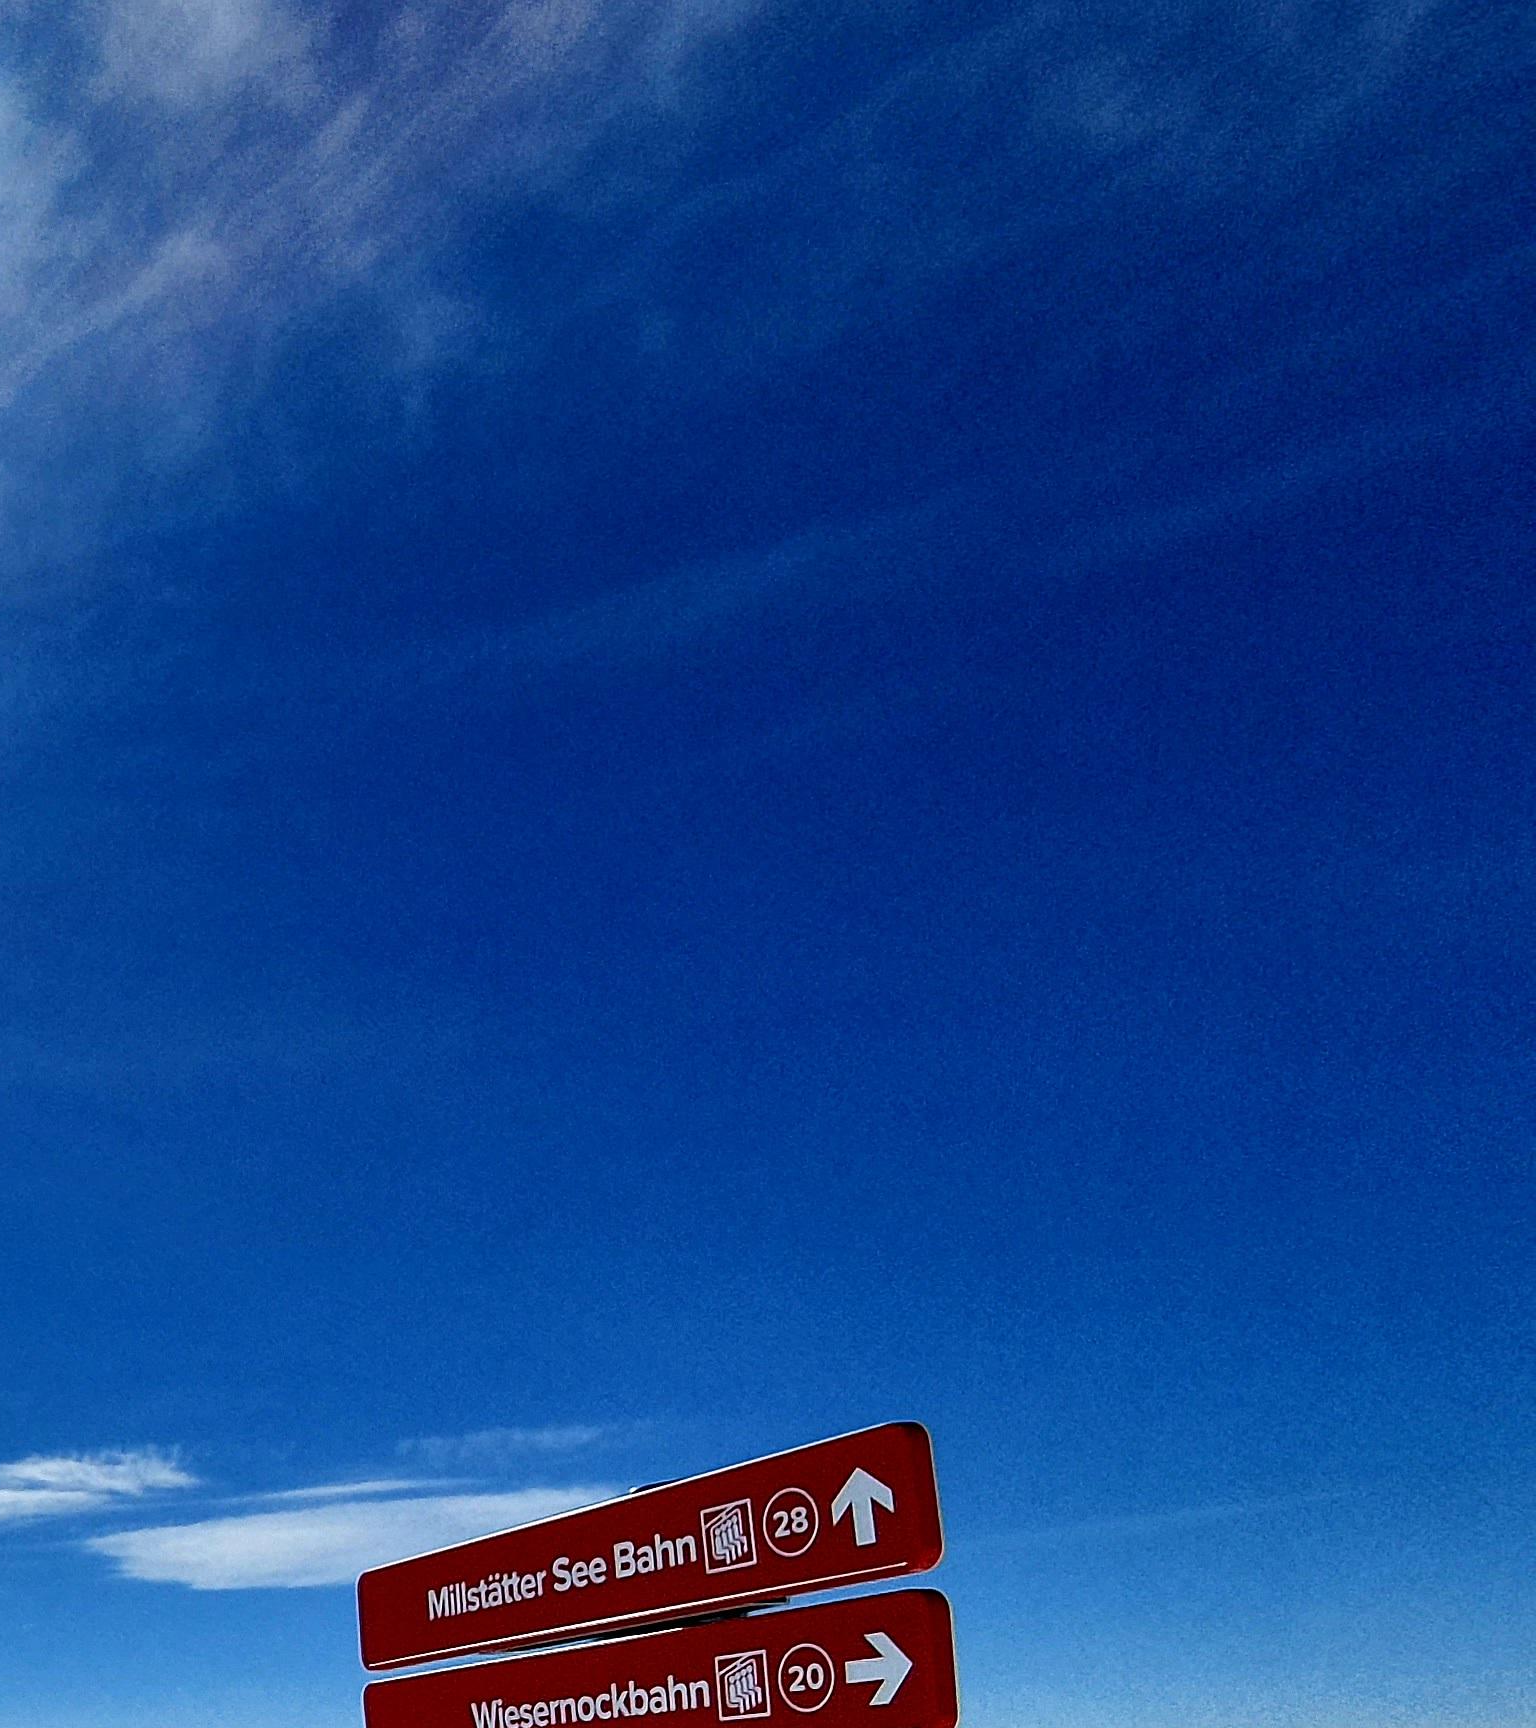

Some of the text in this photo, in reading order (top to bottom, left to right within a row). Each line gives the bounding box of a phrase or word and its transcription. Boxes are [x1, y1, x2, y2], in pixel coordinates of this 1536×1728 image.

[428, 1506, 809, 1621] Millstätter See Bahn 28
[788, 1663, 824, 1692] 20
